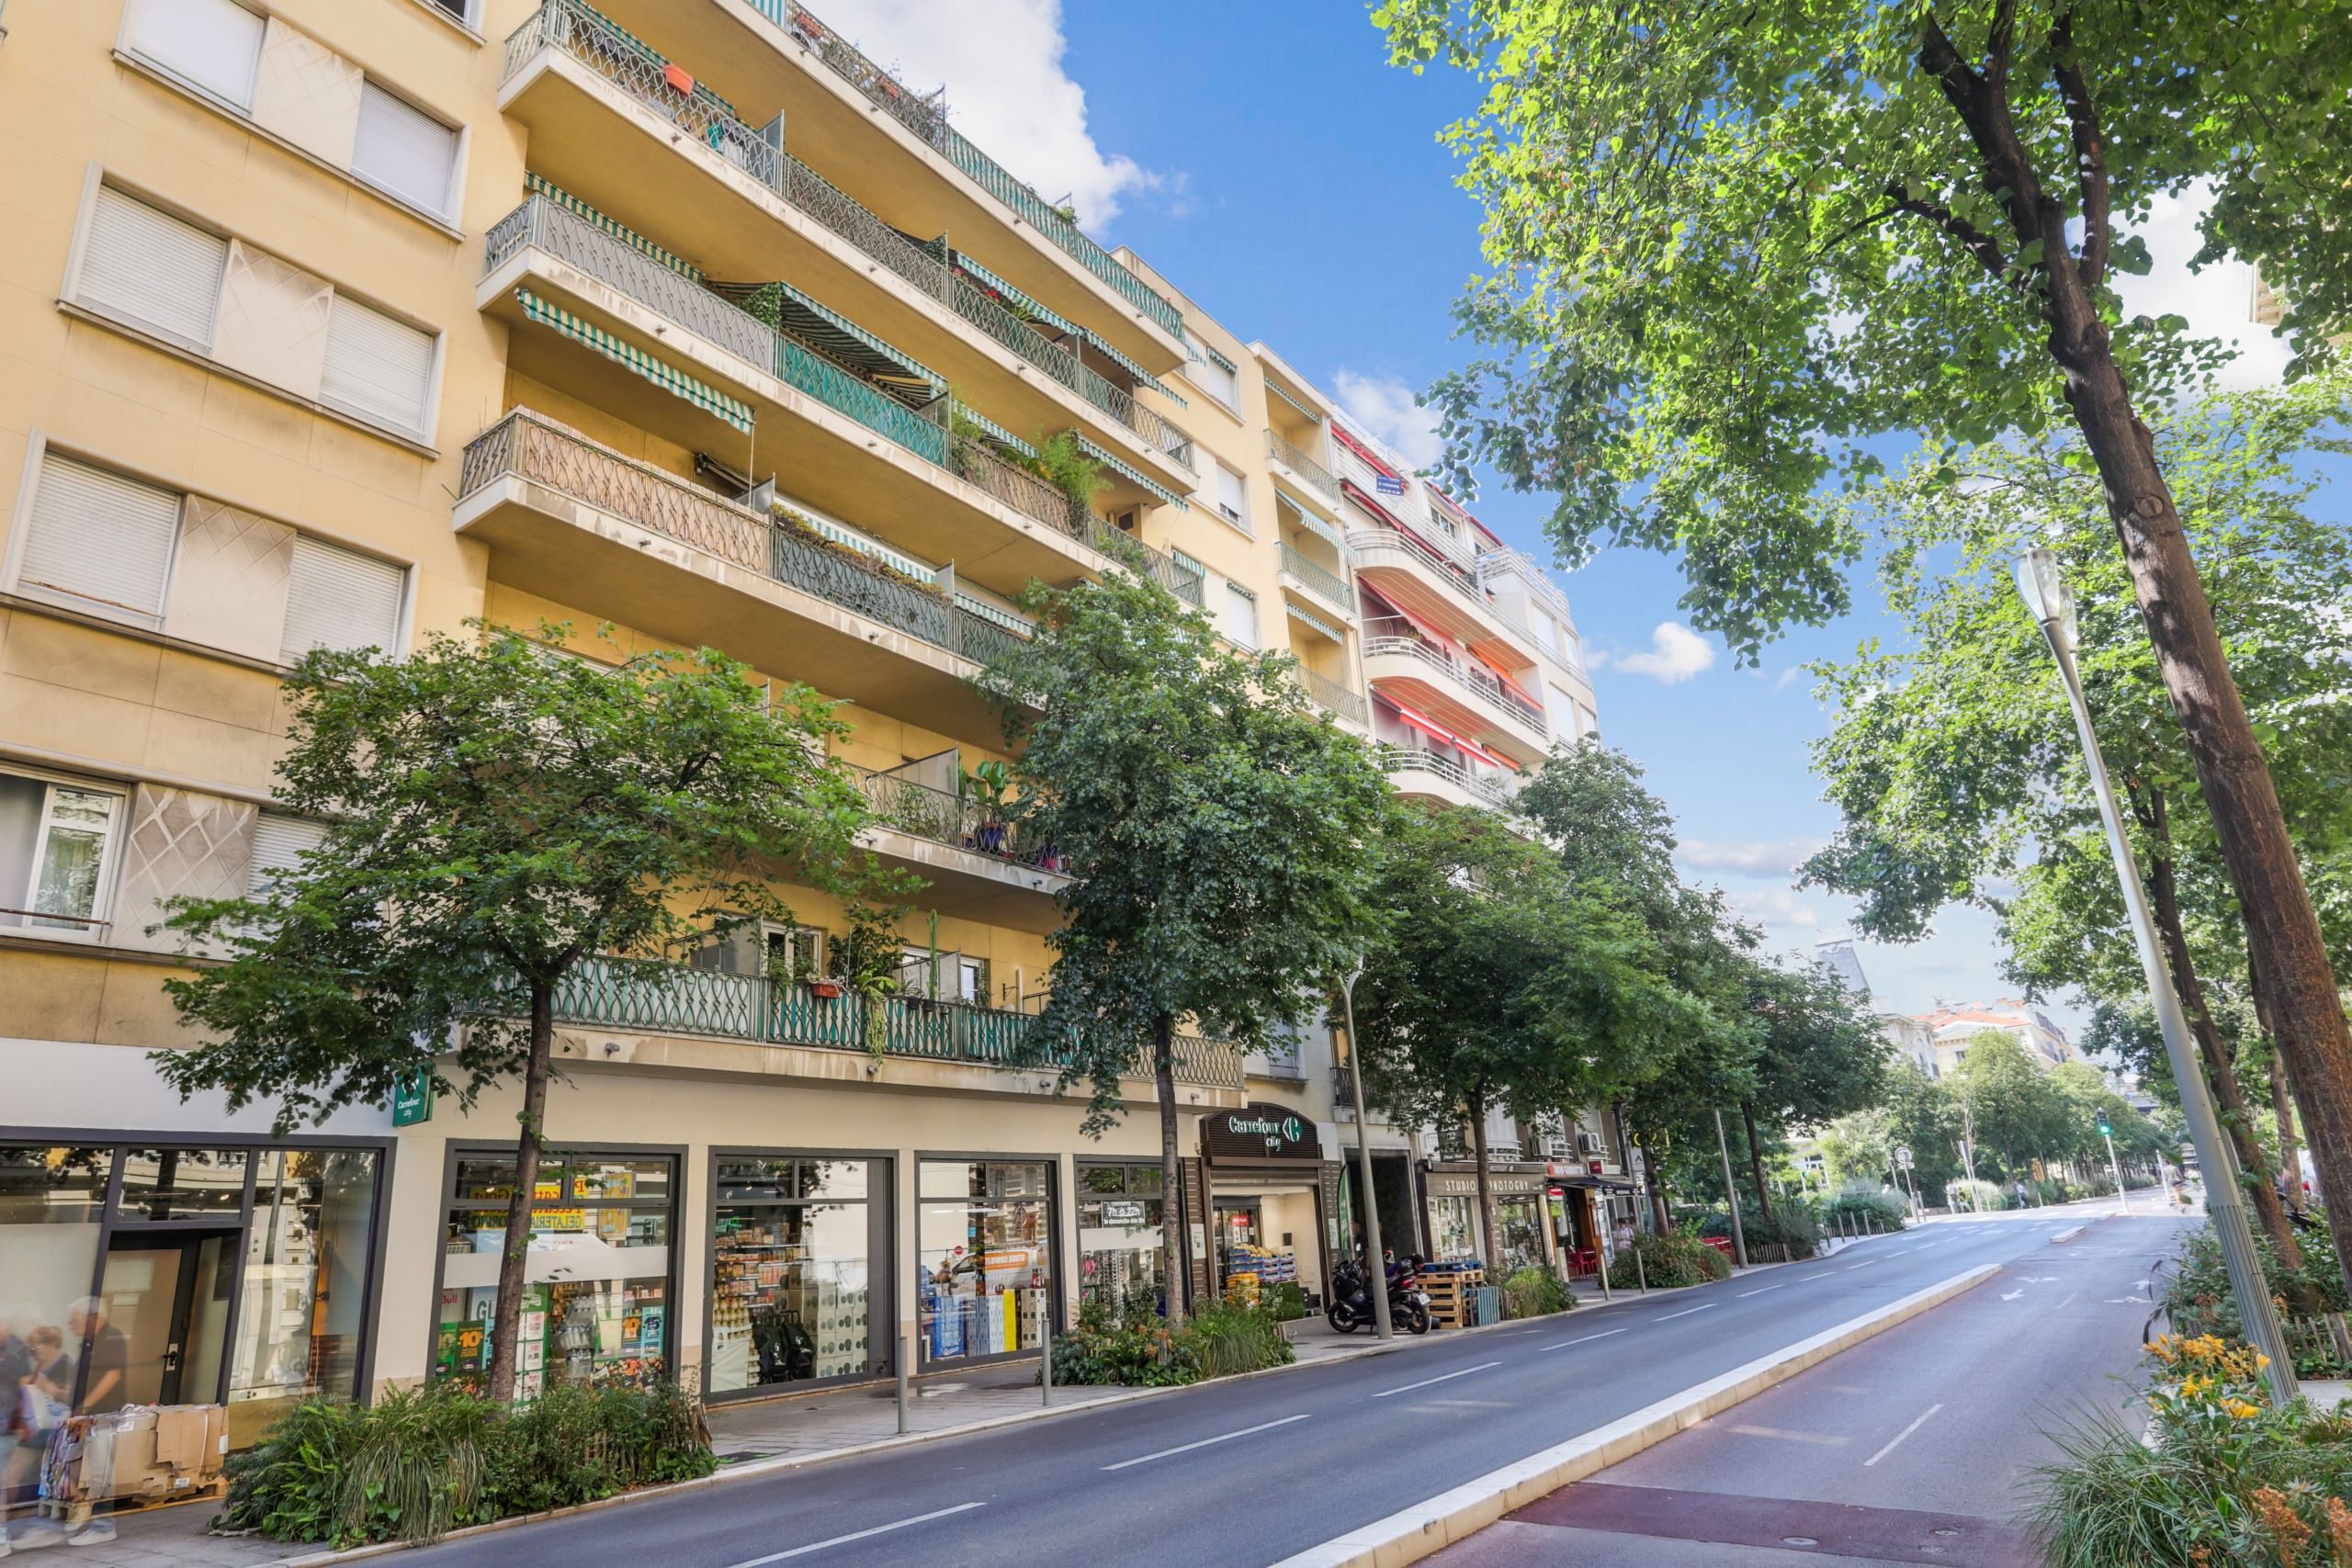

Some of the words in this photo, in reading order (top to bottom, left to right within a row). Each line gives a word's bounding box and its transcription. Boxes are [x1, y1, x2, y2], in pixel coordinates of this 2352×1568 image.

[398, 1098, 420, 1110] Carrefour
[403, 1109, 413, 1119] city
[1228, 1115, 1281, 1134] Carrefour
[1266, 1135, 1282, 1152] city
[1445, 1180, 1476, 1191] STUDIO
[1489, 1179, 1529, 1191] PHOTOGUY
